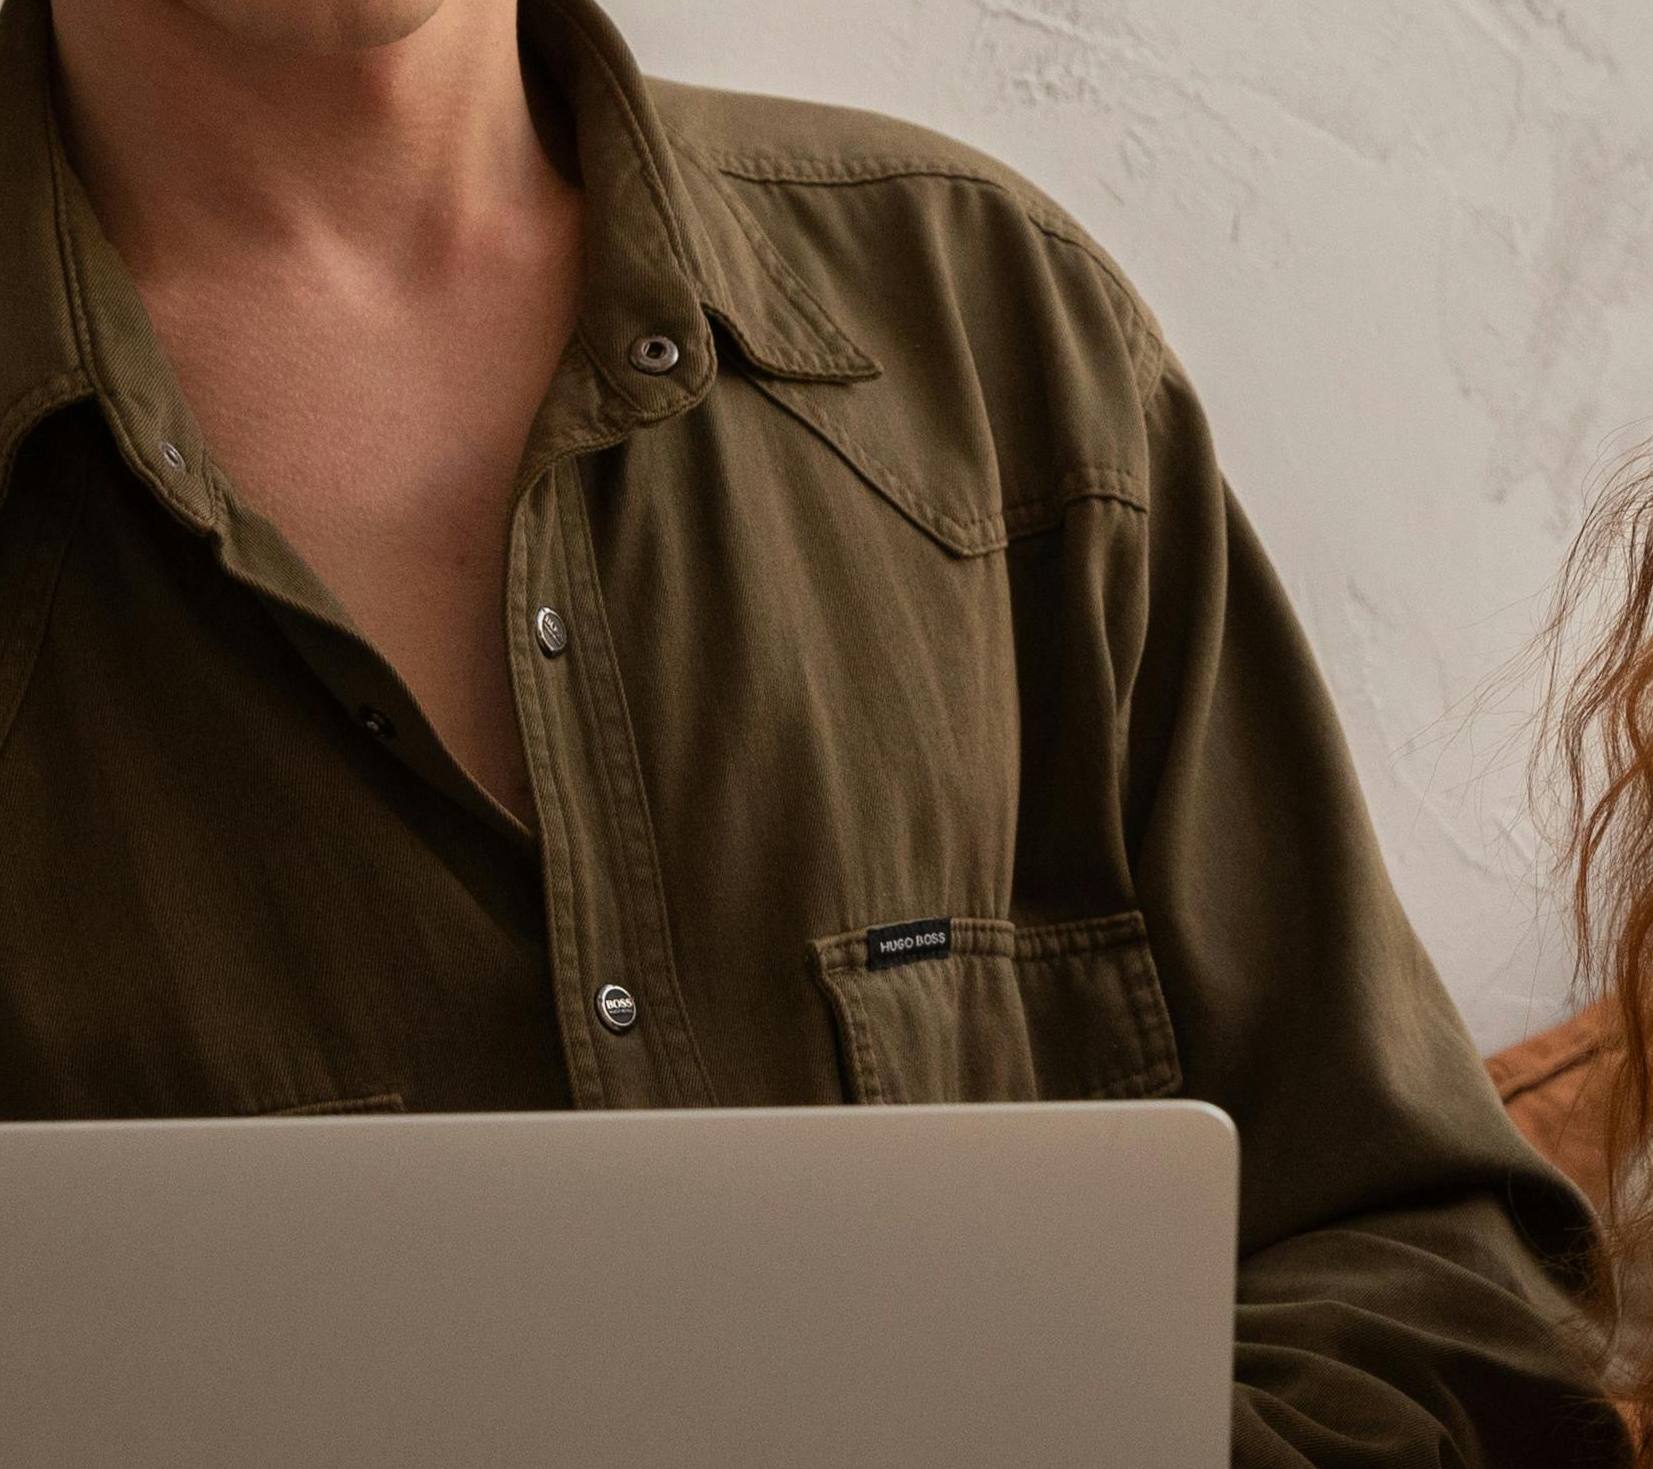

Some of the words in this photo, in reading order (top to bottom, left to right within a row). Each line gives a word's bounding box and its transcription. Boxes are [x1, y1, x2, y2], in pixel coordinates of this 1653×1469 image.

[880, 936, 914, 953] HUGO
[915, 932, 945, 946] BOSS
[606, 998, 632, 1009] BOSS
